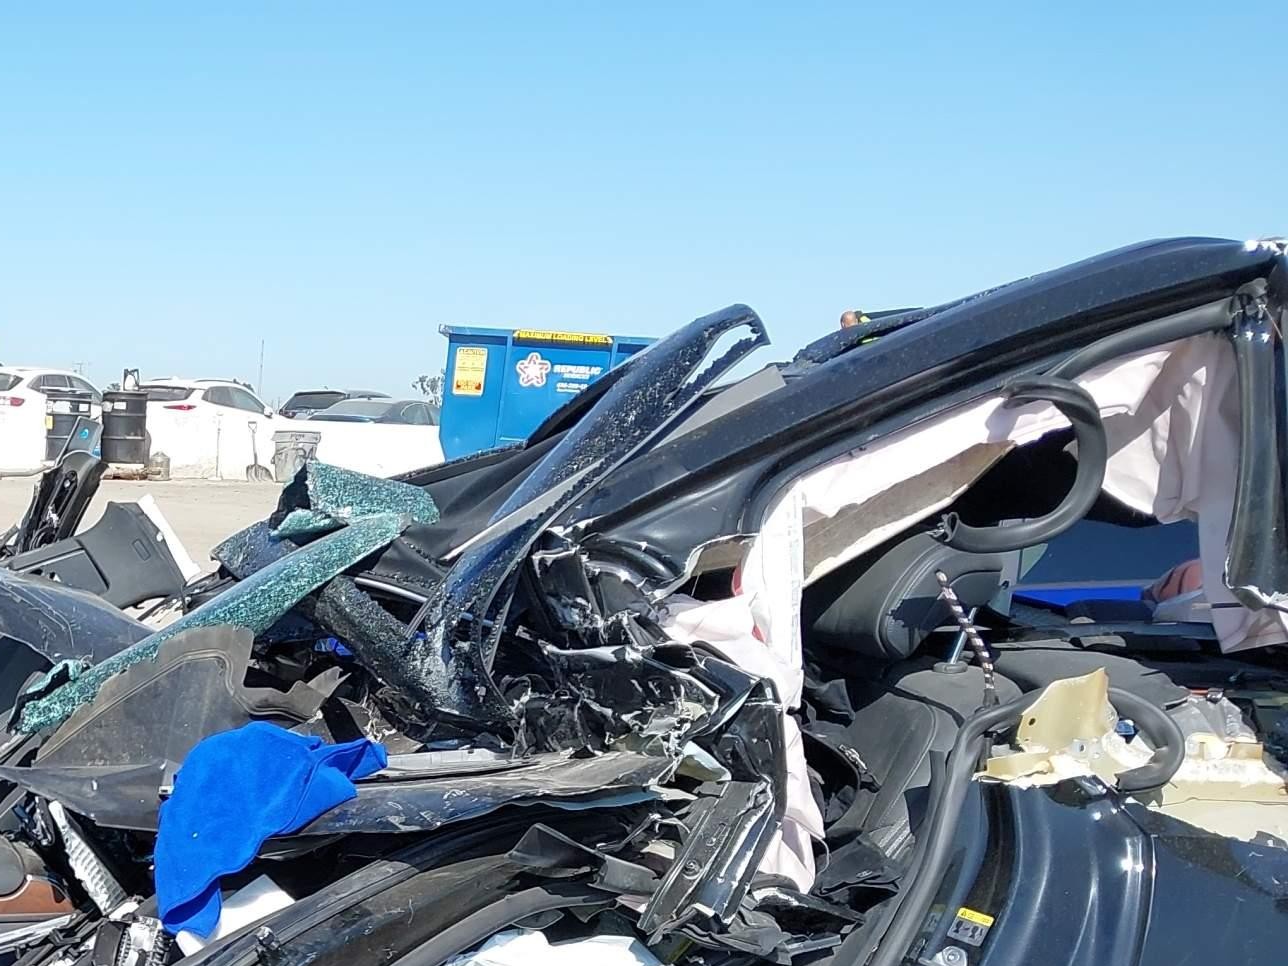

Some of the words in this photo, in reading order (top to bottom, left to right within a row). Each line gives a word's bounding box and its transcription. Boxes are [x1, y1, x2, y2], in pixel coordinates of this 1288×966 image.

[554, 333, 584, 342] LOADING
[585, 335, 608, 344] LEVEL
[553, 364, 601, 375] REPUBLIC
